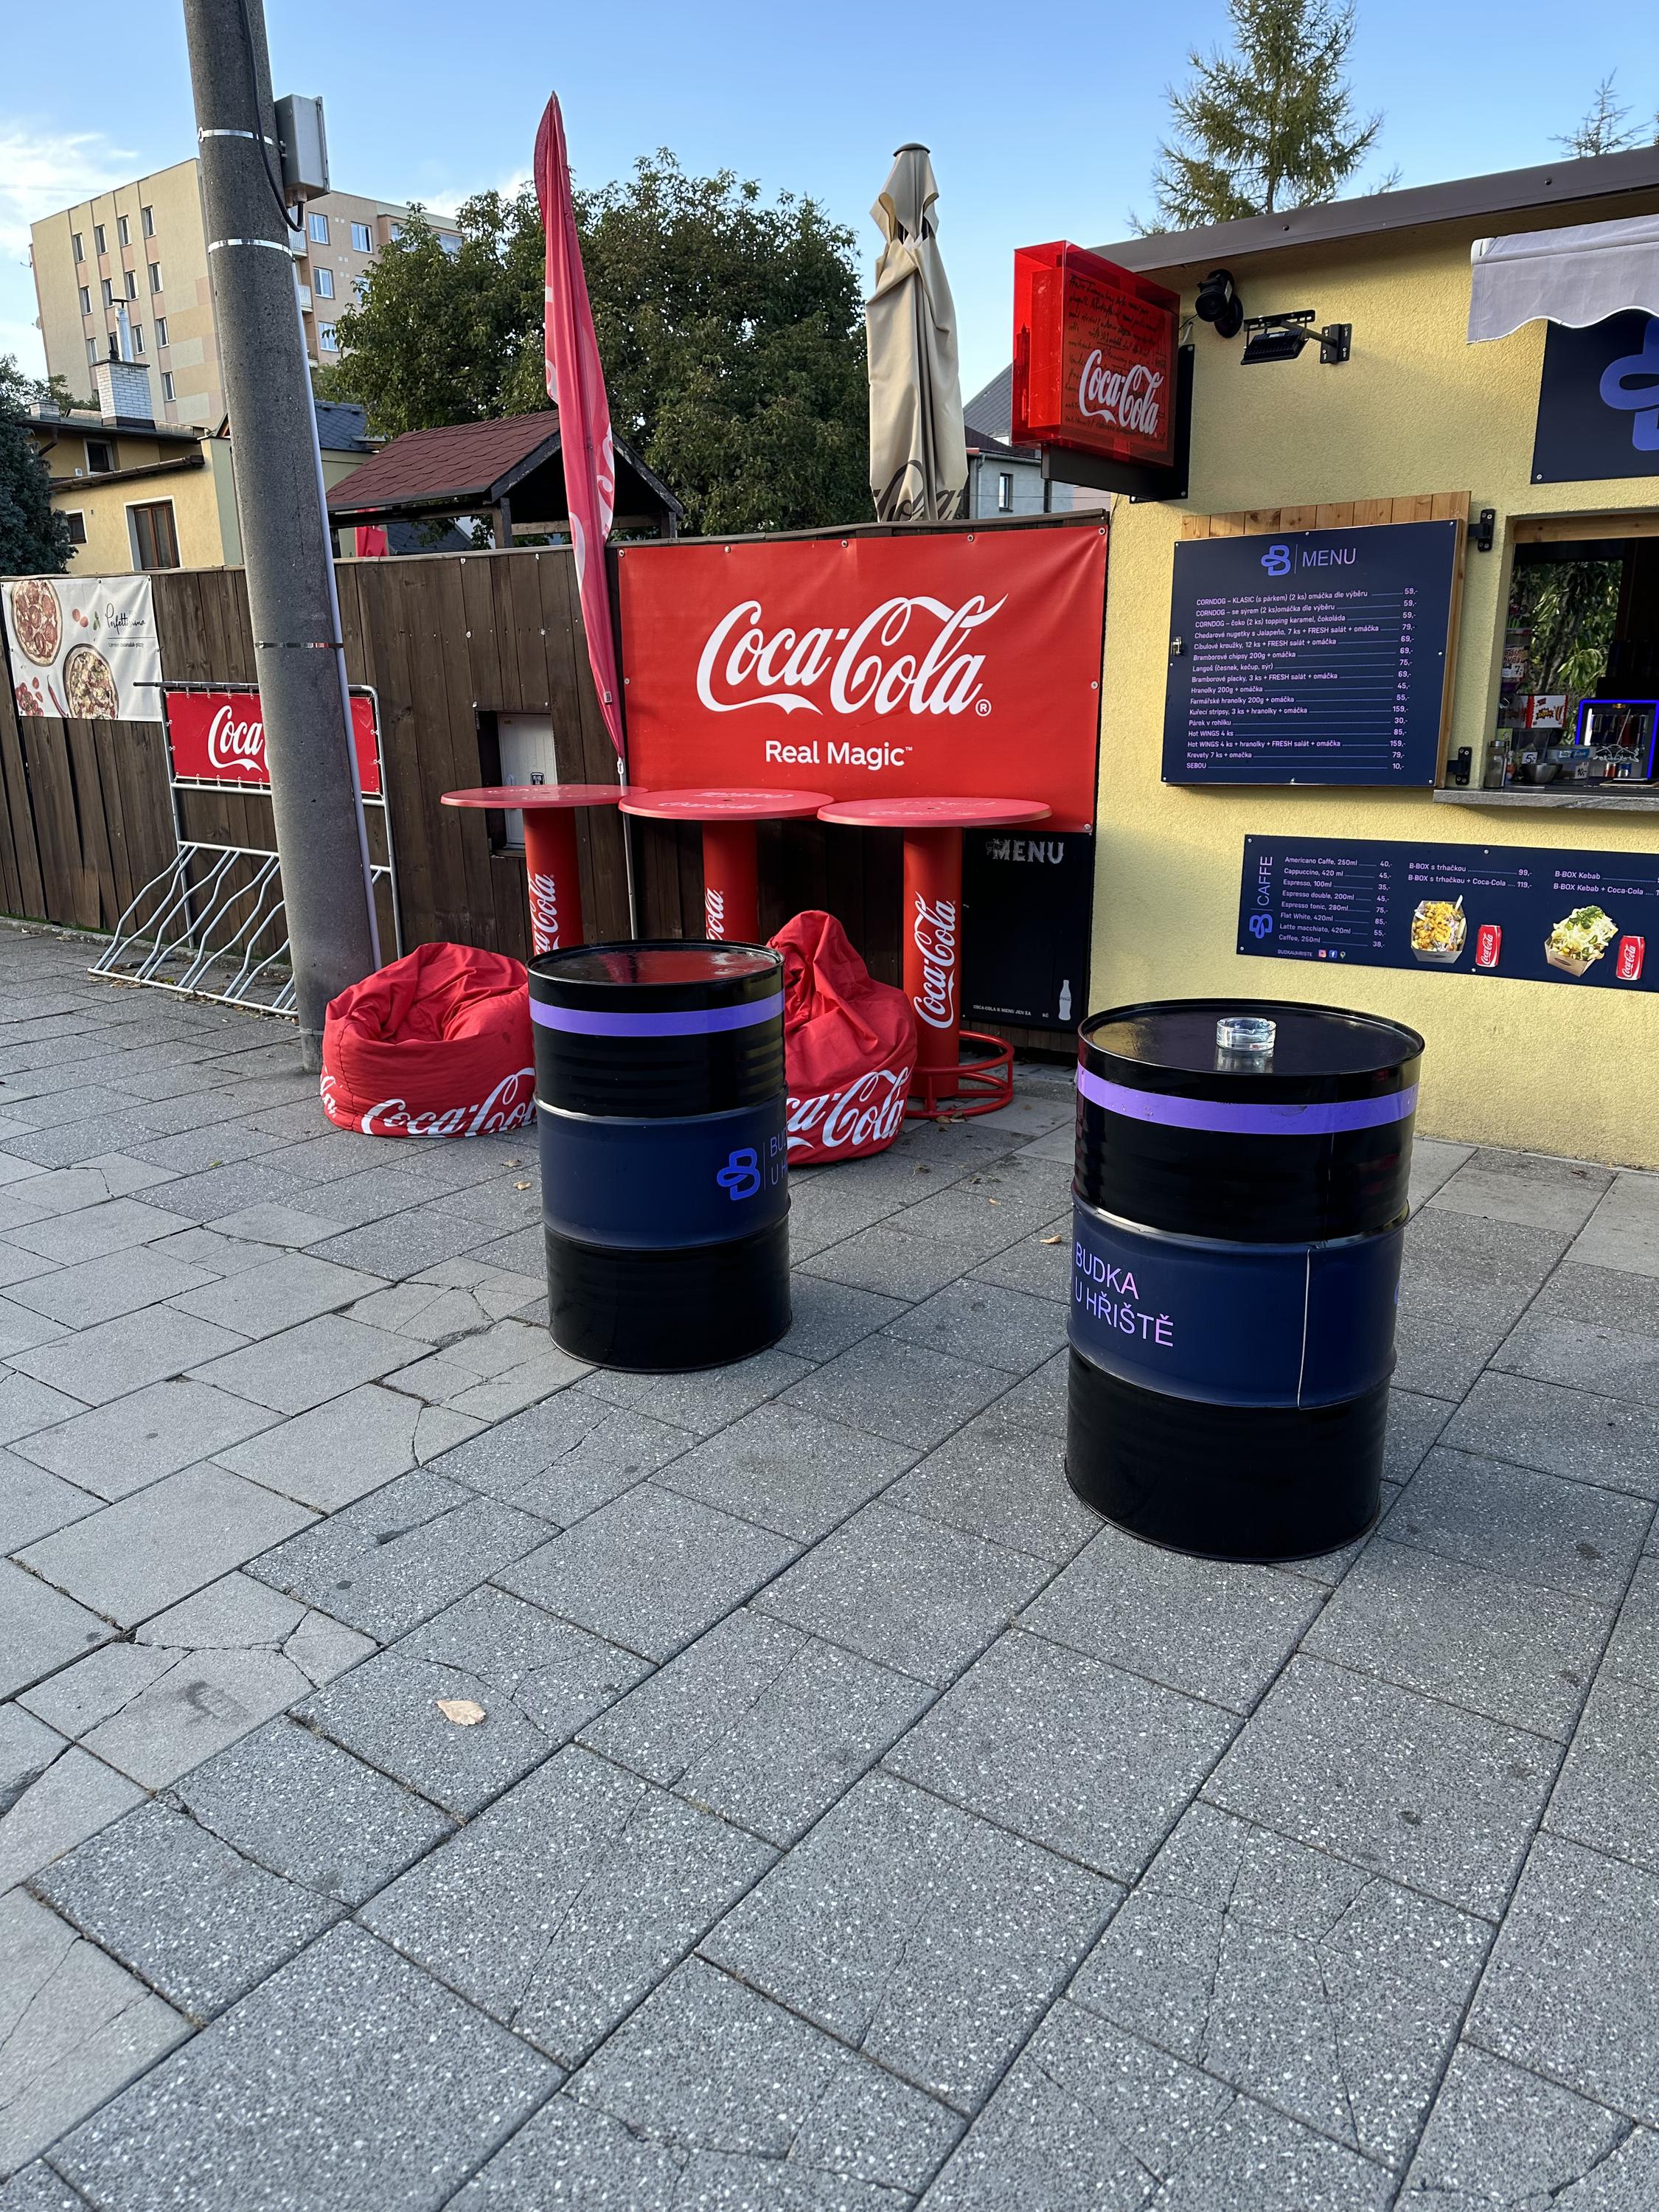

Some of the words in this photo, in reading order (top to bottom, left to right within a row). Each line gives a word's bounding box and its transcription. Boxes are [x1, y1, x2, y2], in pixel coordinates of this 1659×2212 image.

[1079, 349, 1164, 434] Coca-Cola
[1302, 548, 1356, 567] MENU
[1195, 597, 1226, 606] CORNDOG
[1231, 595, 1255, 604] KLASIC
[1262, 593, 1288, 603] párkem)
[1288, 593, 1296, 601] (2
[1296, 592, 1307, 601] ks)
[1307, 591, 1332, 599] omáčka
[1345, 589, 1368, 599] výběru
[1404, 587, 1418, 595] 59,-
[1195, 608, 1225, 617] CORNDOG
[1239, 608, 1259, 616] sýrem
[1259, 605, 1267, 614] (2
[1312, 602, 1335, 612] výběru
[1403, 599, 1417, 607] 59,-
[1194, 619, 1225, 628] CORNDOG
[1245, 618, 1253, 626] (2
[1253, 617, 1264, 625] ks)
[1265, 617, 1288, 625] topping
[1289, 615, 1316, 623] karamel,
[1316, 613, 1346, 622] čokoláda
[1402, 611, 1416, 619] 59,-
[1194, 630, 1225, 639] Chedarové
[1225, 630, 1251, 639] nugetky
[1307, 626, 1329, 634] FRESH
[1329, 625, 1346, 633] salát
[1353, 624, 1379, 632] omáčka
[1402, 622, 1415, 630] 79,-
[1193, 642, 1218, 650] Cibulové
[1311, 637, 1337, 645] omáčka
[1400, 634, 1414, 643] 69,-
[1192, 653, 1228, 661] Bramborové
[1228, 653, 1248, 661] chipsy
[1248, 651, 1266, 660] 200g
[1271, 650, 1296, 658] omáčka
[1399, 646, 1413, 654] 69,-
[1192, 664, 1214, 673] Langoš
[1261, 661, 1273, 671] sýr)
[1399, 658, 1413, 666] 75,-
[1312, 672, 1338, 680] omáčka
[1397, 669, 1411, 678] 69,-
[1190, 686, 1217, 695] Hranolky
[1217, 686, 1234, 694] 200g
[1397, 681, 1411, 689] 45,-
[1220, 696, 1247, 705] hranolky
[1247, 696, 1264, 705] 200g
[1396, 693, 1410, 701] 55,-
[1250, 706, 1277, 715] hranolky
[1392, 705, 1408, 713] 159,-
[1211, 718, 1231, 726] rohlíku
[1394, 716, 1408, 724] 30,-
[208, 705, 268, 773] Coca
[1393, 728, 1407, 736] 85,-
[1239, 740, 1265, 748] hranolky
[1315, 739, 1340, 747] omáčka
[765, 740, 820, 764] Real
[1186, 751, 1209, 759] Krevety
[1391, 751, 1405, 759] 79,-
[1391, 762, 1404, 770] 10,-
[1284, 856, 1317, 864] Americano
[1317, 857, 1336, 866] Caffe,
[1379, 860, 1392, 868] 40,-
[1283, 867, 1321, 876] Cappuccino,
[1321, 869, 1335, 877] 420
[1378, 872, 1391, 880] 45,-
[1409, 862, 1429, 870] B-BOX
[1437, 863, 1467, 872] trhačkou
[1518, 869, 1532, 877] 99,-
[1554, 870, 1577, 878] B-BOX
[1579, 872, 1601, 880] Kebab
[1256, 856, 1273, 906] CAFFE
[1282, 878, 1312, 886] Espresso,
[1312, 880, 1332, 888] 100ml
[1377, 883, 1391, 891] 35,-
[1408, 874, 1428, 882] B-BOX
[1436, 875, 1465, 884] trhačkou
[1472, 877, 1506, 886] Coca-Cola
[1517, 881, 1532, 889] 119,-
[1281, 889, 1310, 897] Espresso
[1310, 891, 1332, 900] double,
[1333, 892, 1354, 900] 200ml
[1376, 894, 1389, 902] 45,-
[1553, 883, 1576, 891] B-BOX
[1577, 884, 1599, 892] Kebab
[1607, 886, 1644, 895] Coca-Cola
[1281, 900, 1309, 909] Espresso
[1310, 902, 1326, 911] tonic,
[1328, 903, 1349, 911] 280ml
[1375, 905, 1388, 914] 75,-
[1293, 912, 1312, 920] White,
[1312, 914, 1333, 922] 420ml
[1374, 917, 1387, 925] 85,-
[1296, 925, 1329, 933] macchiato,
[1330, 926, 1352, 934] 420ml
[1373, 928, 1386, 936] 55,-
[1300, 935, 1321, 943] 250ml
[1372, 940, 1385, 948] 38,-
[914, 891, 956, 1029] Coca-Cola
[1075, 1241, 1139, 1301] BUDKA
[1075, 1276, 1082, 1303] U
[1086, 1287, 1174, 1347] HŘIŠTĚ
